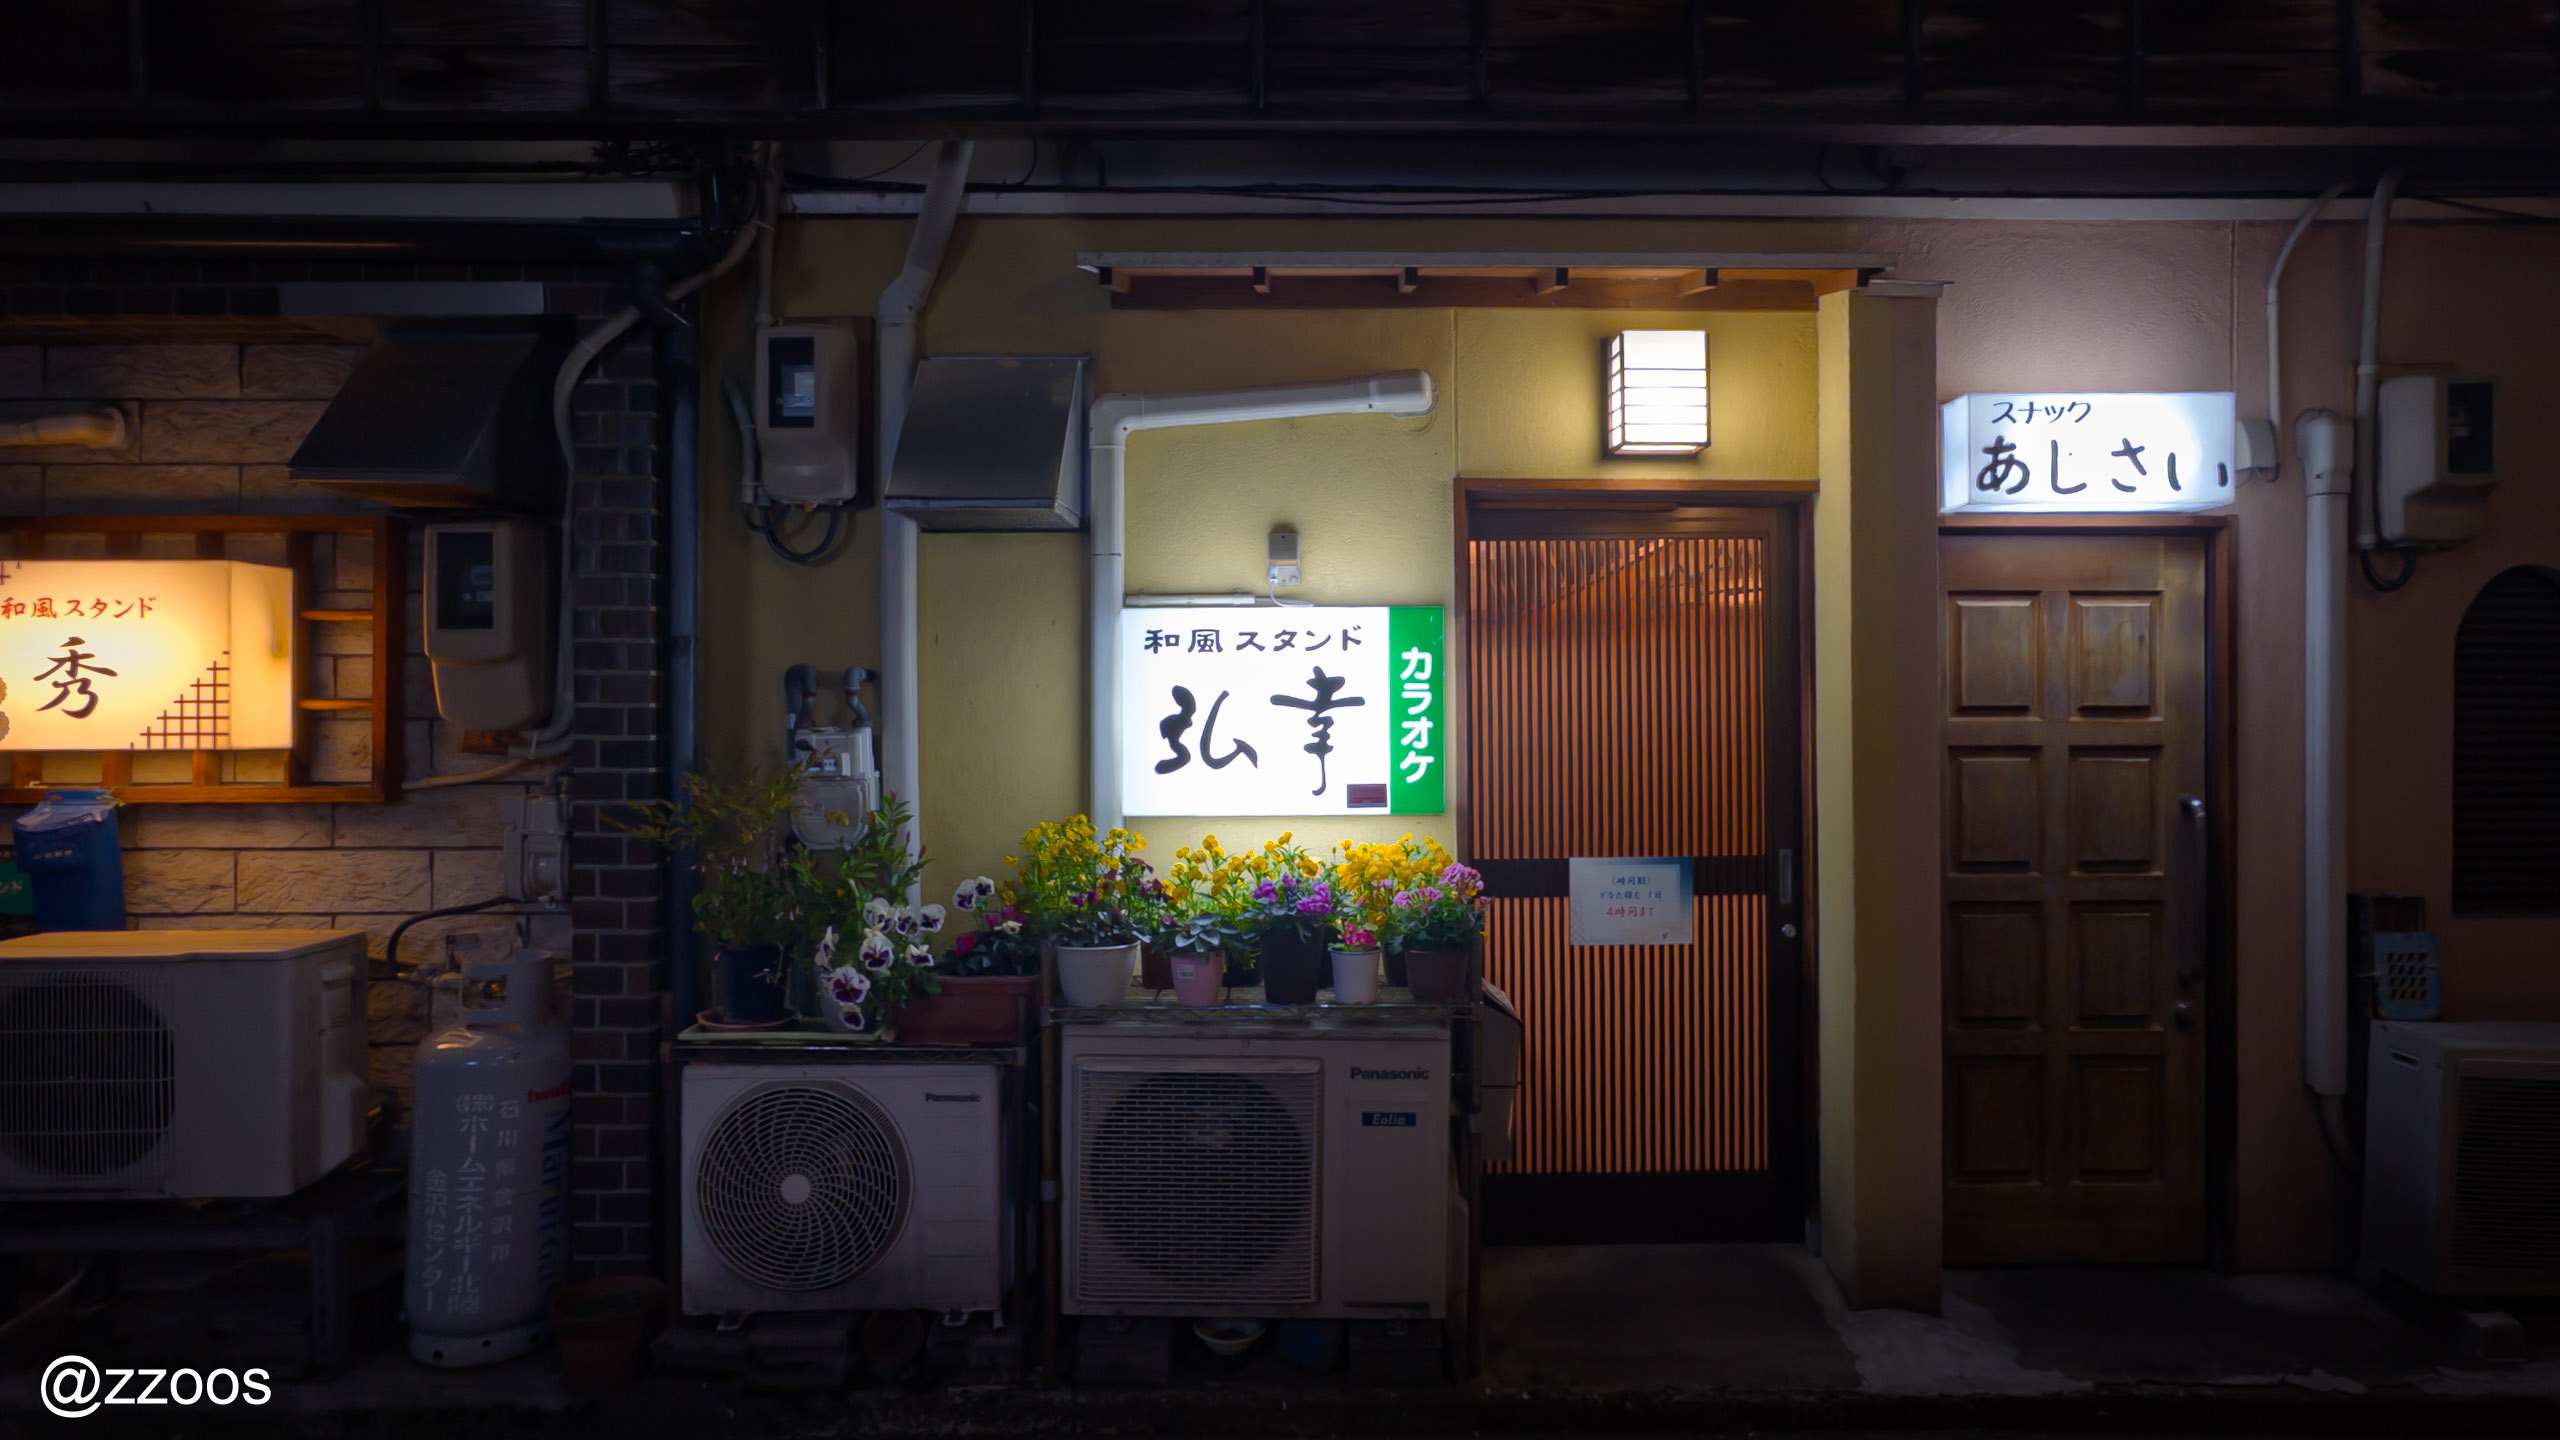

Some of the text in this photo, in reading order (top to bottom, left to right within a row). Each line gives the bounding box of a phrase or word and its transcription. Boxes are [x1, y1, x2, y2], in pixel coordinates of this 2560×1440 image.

[1991, 401, 2091, 424] スナック
[1976, 435, 2229, 494] あじさい
[0, 597, 156, 620] 和風スタンド
[1144, 625, 1362, 654] 和風スタンド
[33, 636, 118, 719] 秀
[1400, 647, 1434, 784] カラオケ
[1350, 1066, 1430, 1080] Panasonic
[925, 1092, 981, 1102] Panasonic
[422, 1168, 449, 1313] 金沢センター
